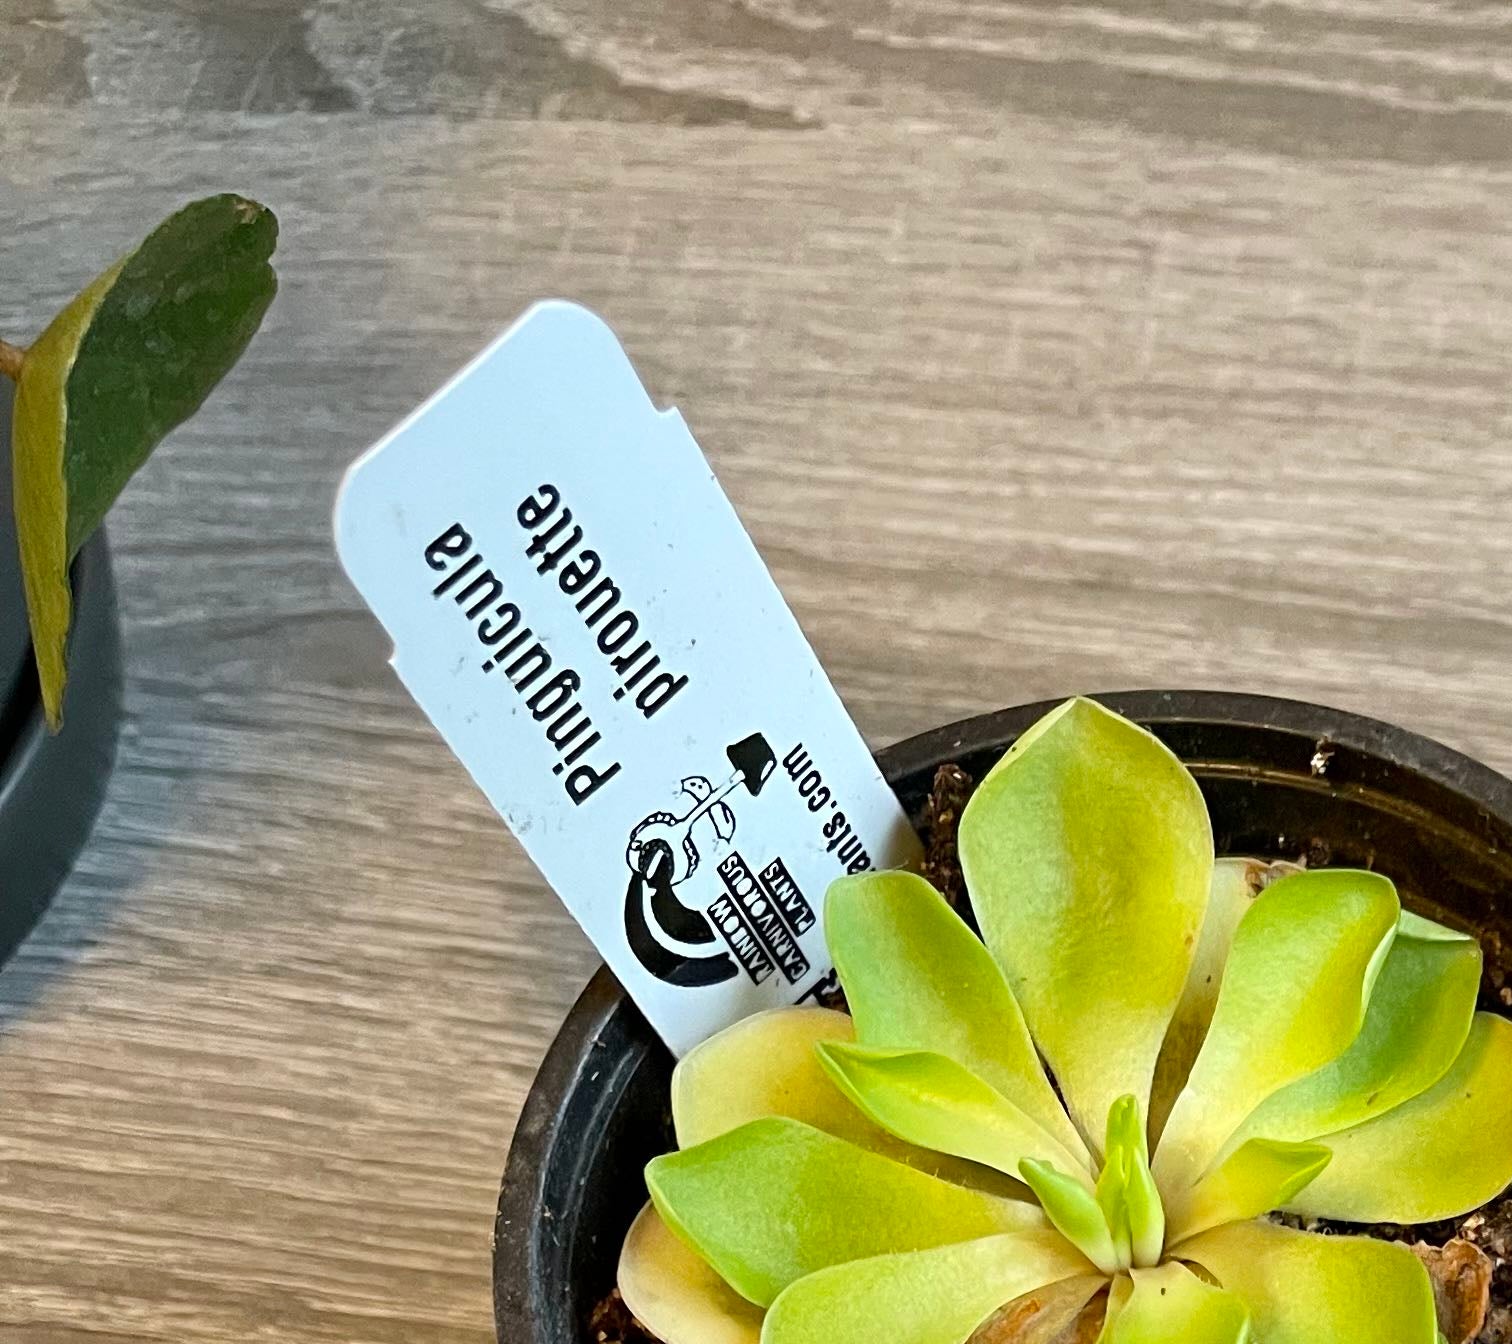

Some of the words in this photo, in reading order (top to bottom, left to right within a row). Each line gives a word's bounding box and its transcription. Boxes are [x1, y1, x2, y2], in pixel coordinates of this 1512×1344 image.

[423, 522, 622, 806] Pinguicula
[516, 483, 690, 719] pirouette
[721, 854, 809, 980] CARNIVOROUS
[763, 862, 815, 933] PLANTS
